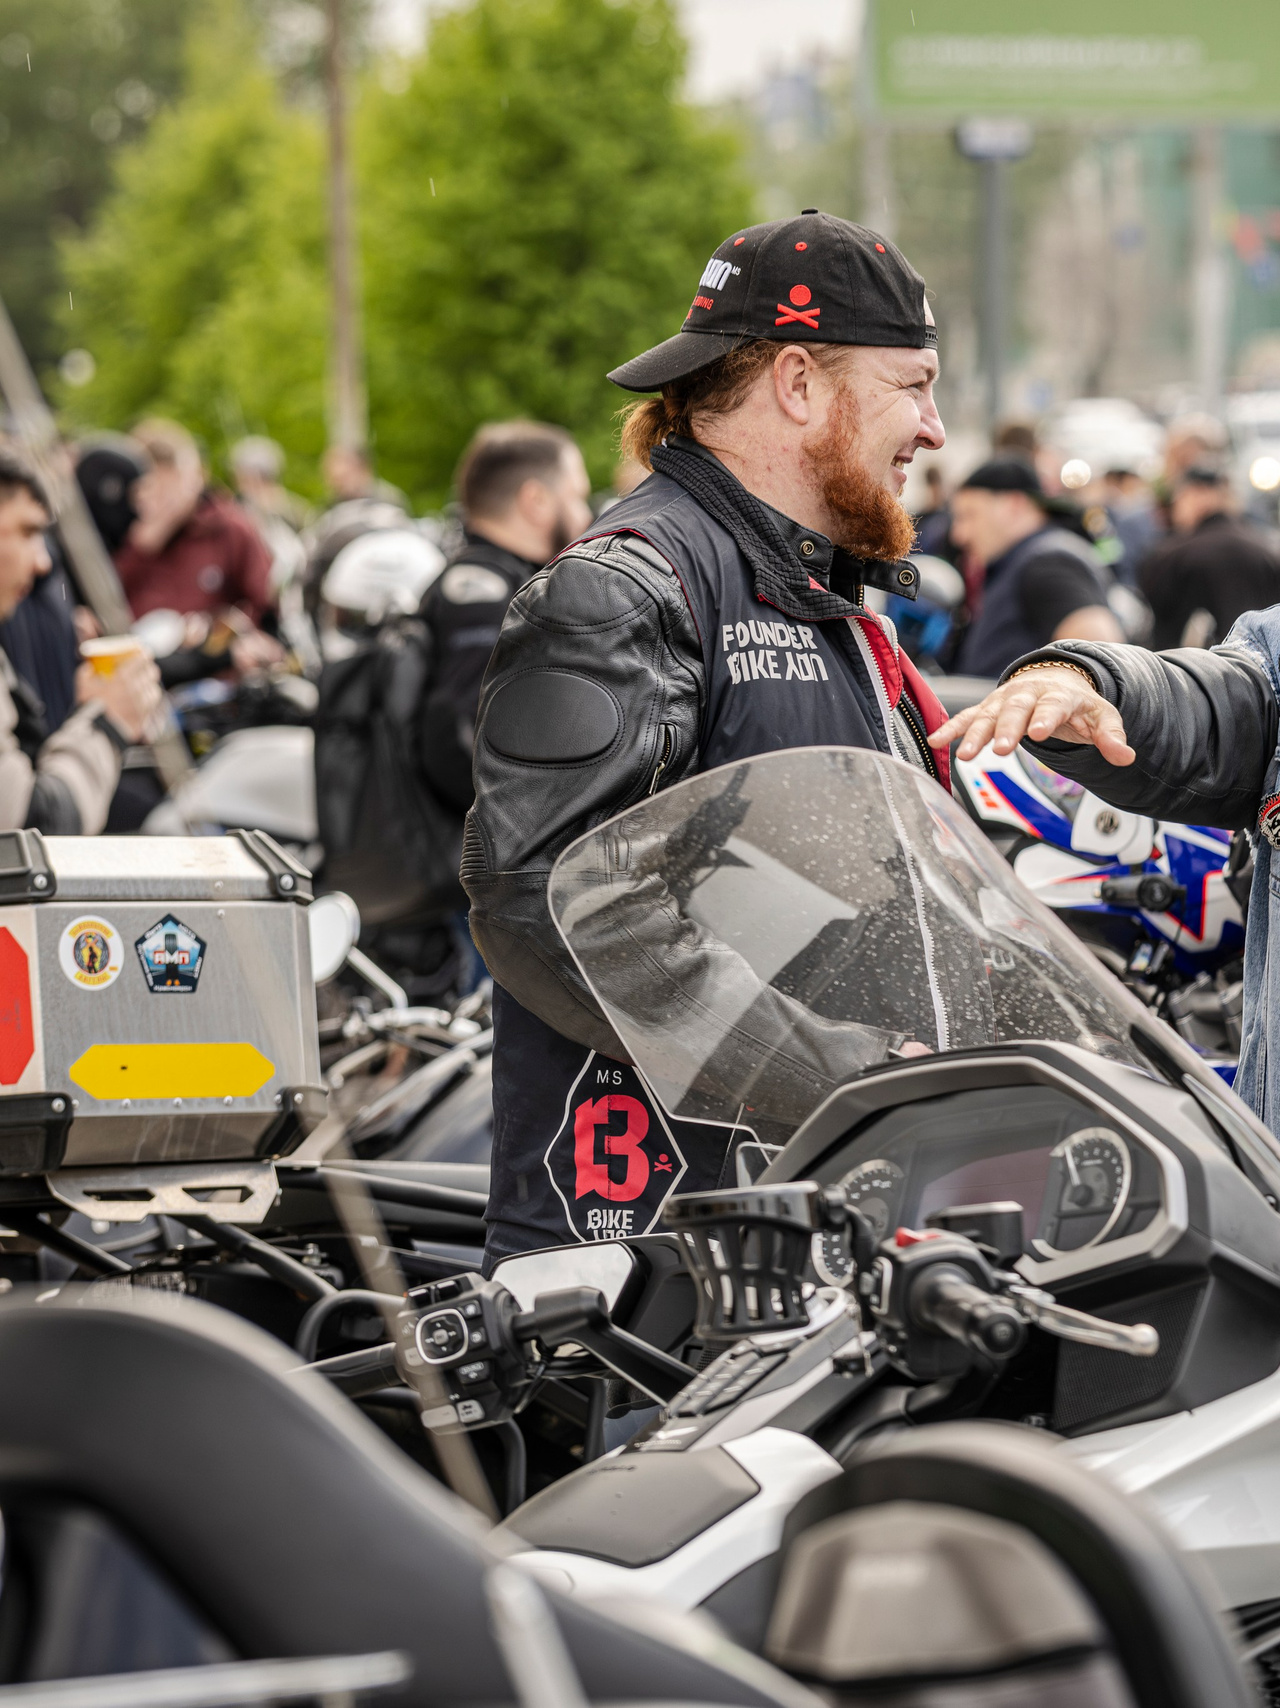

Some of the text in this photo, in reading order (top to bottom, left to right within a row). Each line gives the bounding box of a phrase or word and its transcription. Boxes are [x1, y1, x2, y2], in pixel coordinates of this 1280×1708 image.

[722, 620, 818, 652] FOUNDER
[727, 650, 781, 685] BIKE
[597, 1070, 623, 1085] MS
[586, 1208, 634, 1230] BIKE
